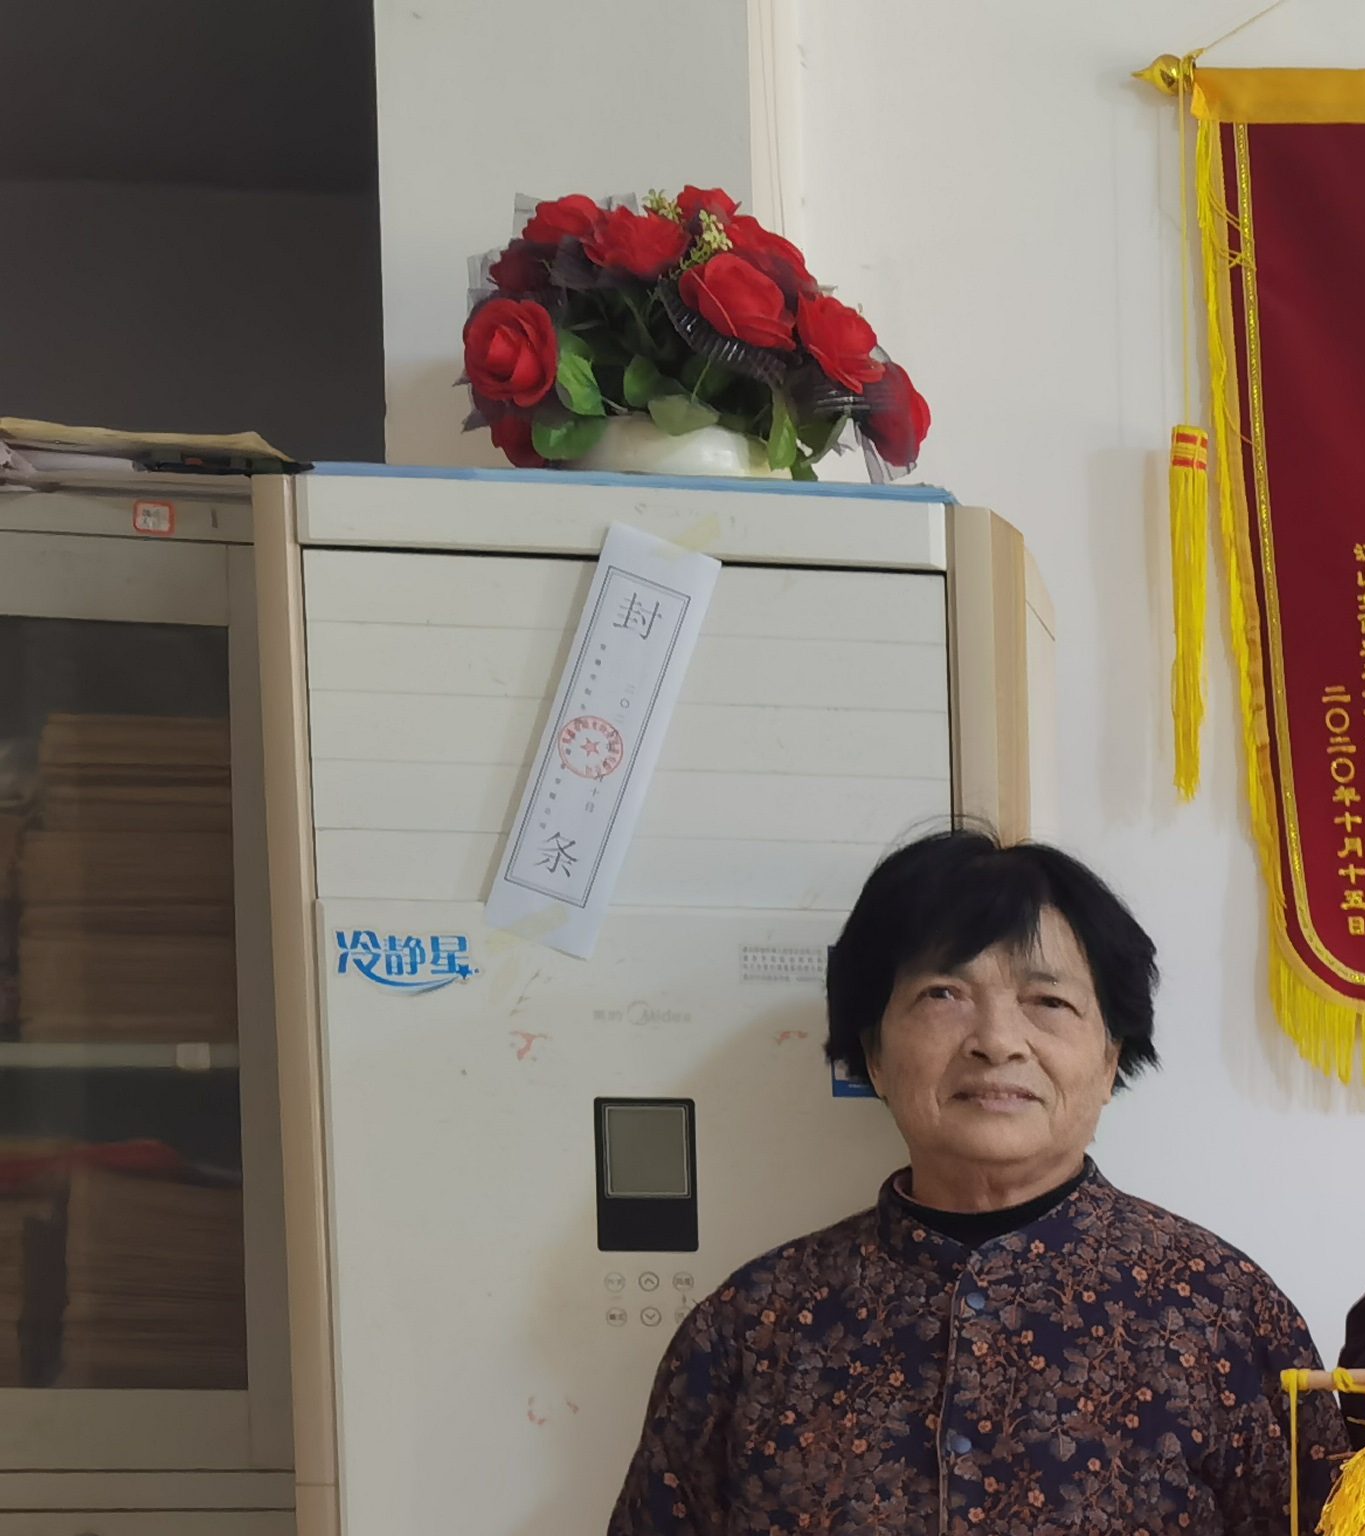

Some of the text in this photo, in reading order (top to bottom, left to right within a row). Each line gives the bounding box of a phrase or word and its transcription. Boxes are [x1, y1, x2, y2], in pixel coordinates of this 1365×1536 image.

[612, 592, 663, 641] 封
[532, 831, 579, 878] 条
[335, 929, 475, 987] 冷静星
